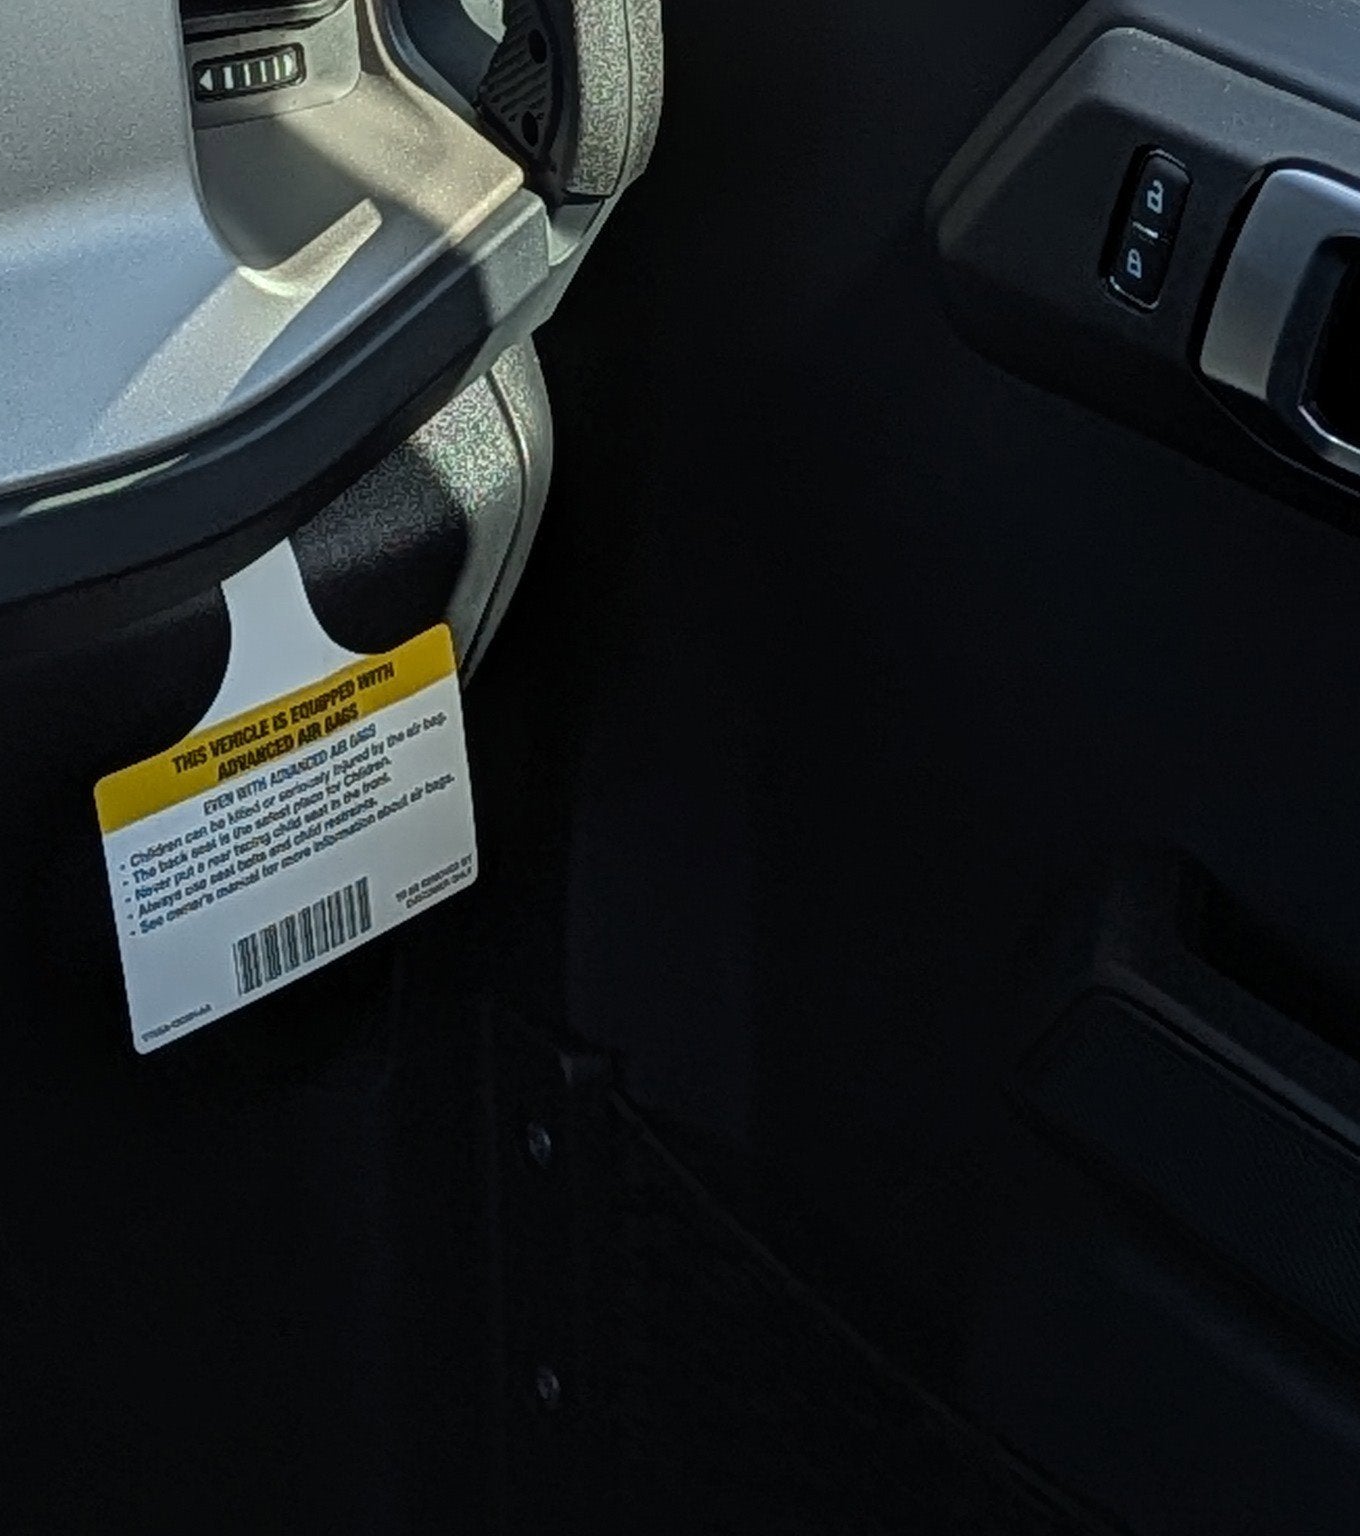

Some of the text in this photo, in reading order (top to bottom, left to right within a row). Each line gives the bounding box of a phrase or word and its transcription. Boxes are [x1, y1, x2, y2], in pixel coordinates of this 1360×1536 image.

[172, 662, 394, 773] THIS VEHICLE IS EQUIPPED WITH
[218, 734, 294, 780] ADVANCED
[297, 722, 321, 746] AIR
